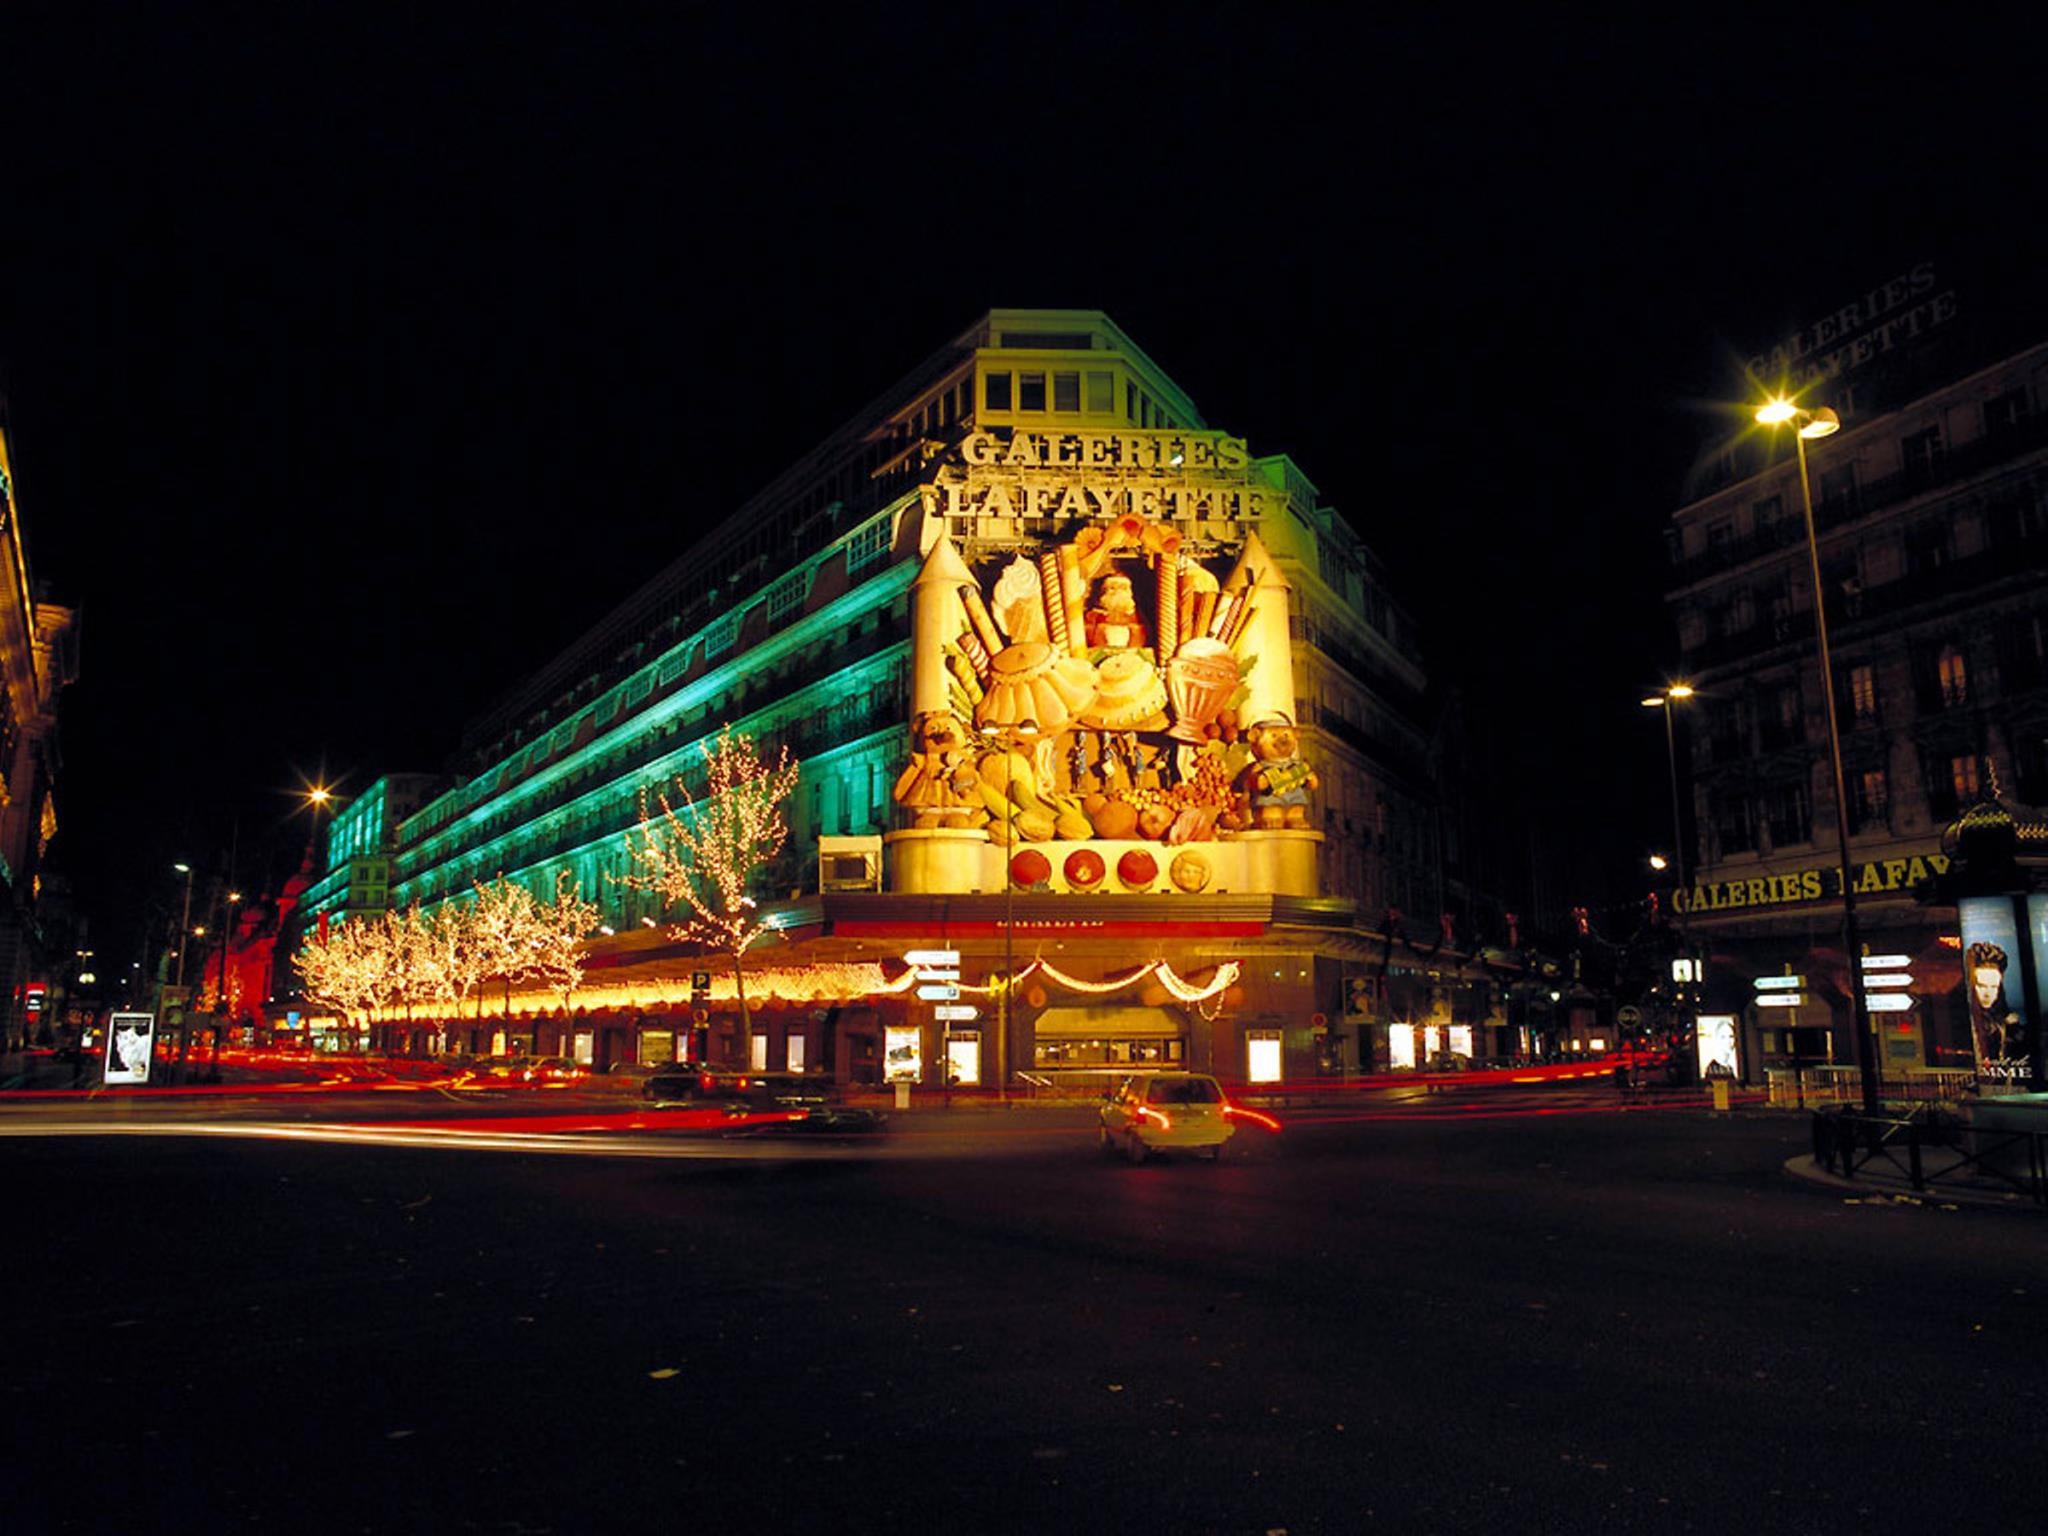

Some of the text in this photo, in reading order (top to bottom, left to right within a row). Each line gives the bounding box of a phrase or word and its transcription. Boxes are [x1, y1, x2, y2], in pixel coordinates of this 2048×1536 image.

[1745, 261, 1936, 378] GALERIES
[961, 432, 1248, 469] GALERIES
[943, 484, 1264, 517] LAFAYETTE
[1672, 869, 1823, 913] GALERIES
[696, 974, 708, 988] P
